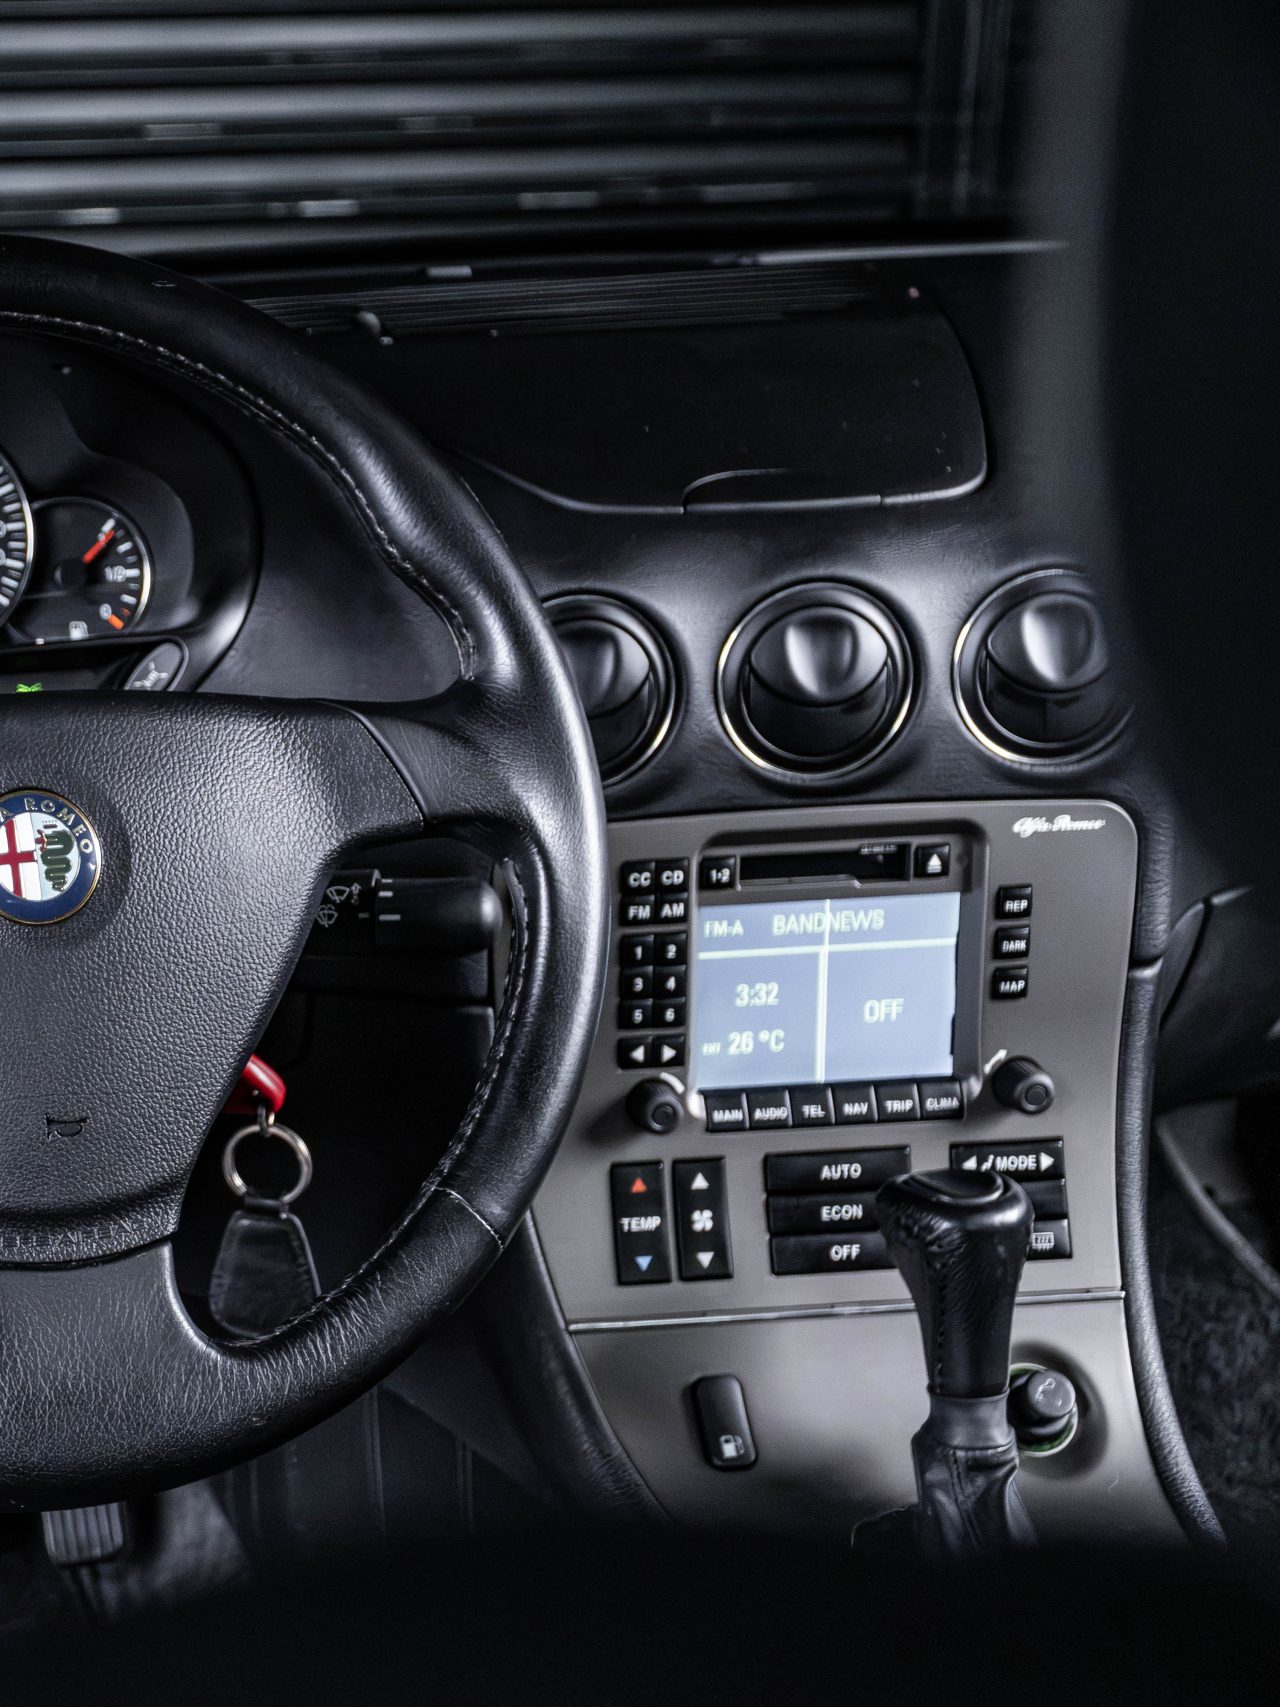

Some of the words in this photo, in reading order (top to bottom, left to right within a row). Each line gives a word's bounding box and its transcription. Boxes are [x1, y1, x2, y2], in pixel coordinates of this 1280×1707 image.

[23, 797, 94, 854] ROMEO
[628, 871, 652, 888] CC
[661, 869, 685, 886] CD
[628, 904, 651, 920] FM
[661, 902, 685, 918] AM
[634, 945, 643, 961] 1
[665, 943, 677, 960] 2
[664, 975, 676, 992] 4
[999, 980, 1026, 994] MAP
[734, 981, 781, 1007] 3:32
[631, 1008, 643, 1024] 5
[664, 1007, 676, 1023] 6
[862, 998, 905, 1023] OFF
[727, 1030, 754, 1056] 26
[754, 1106, 789, 1121] AUDIO
[802, 1104, 826, 1118] TEL
[843, 1102, 869, 1116] NAV
[884, 1099, 914, 1114] TRIP
[995, 1154, 1037, 1172] MODE
[820, 1163, 862, 1181] AUTO
[821, 1203, 864, 1222] ECON
[620, 1215, 662, 1233] TEMP
[829, 1243, 861, 1262] OFF
